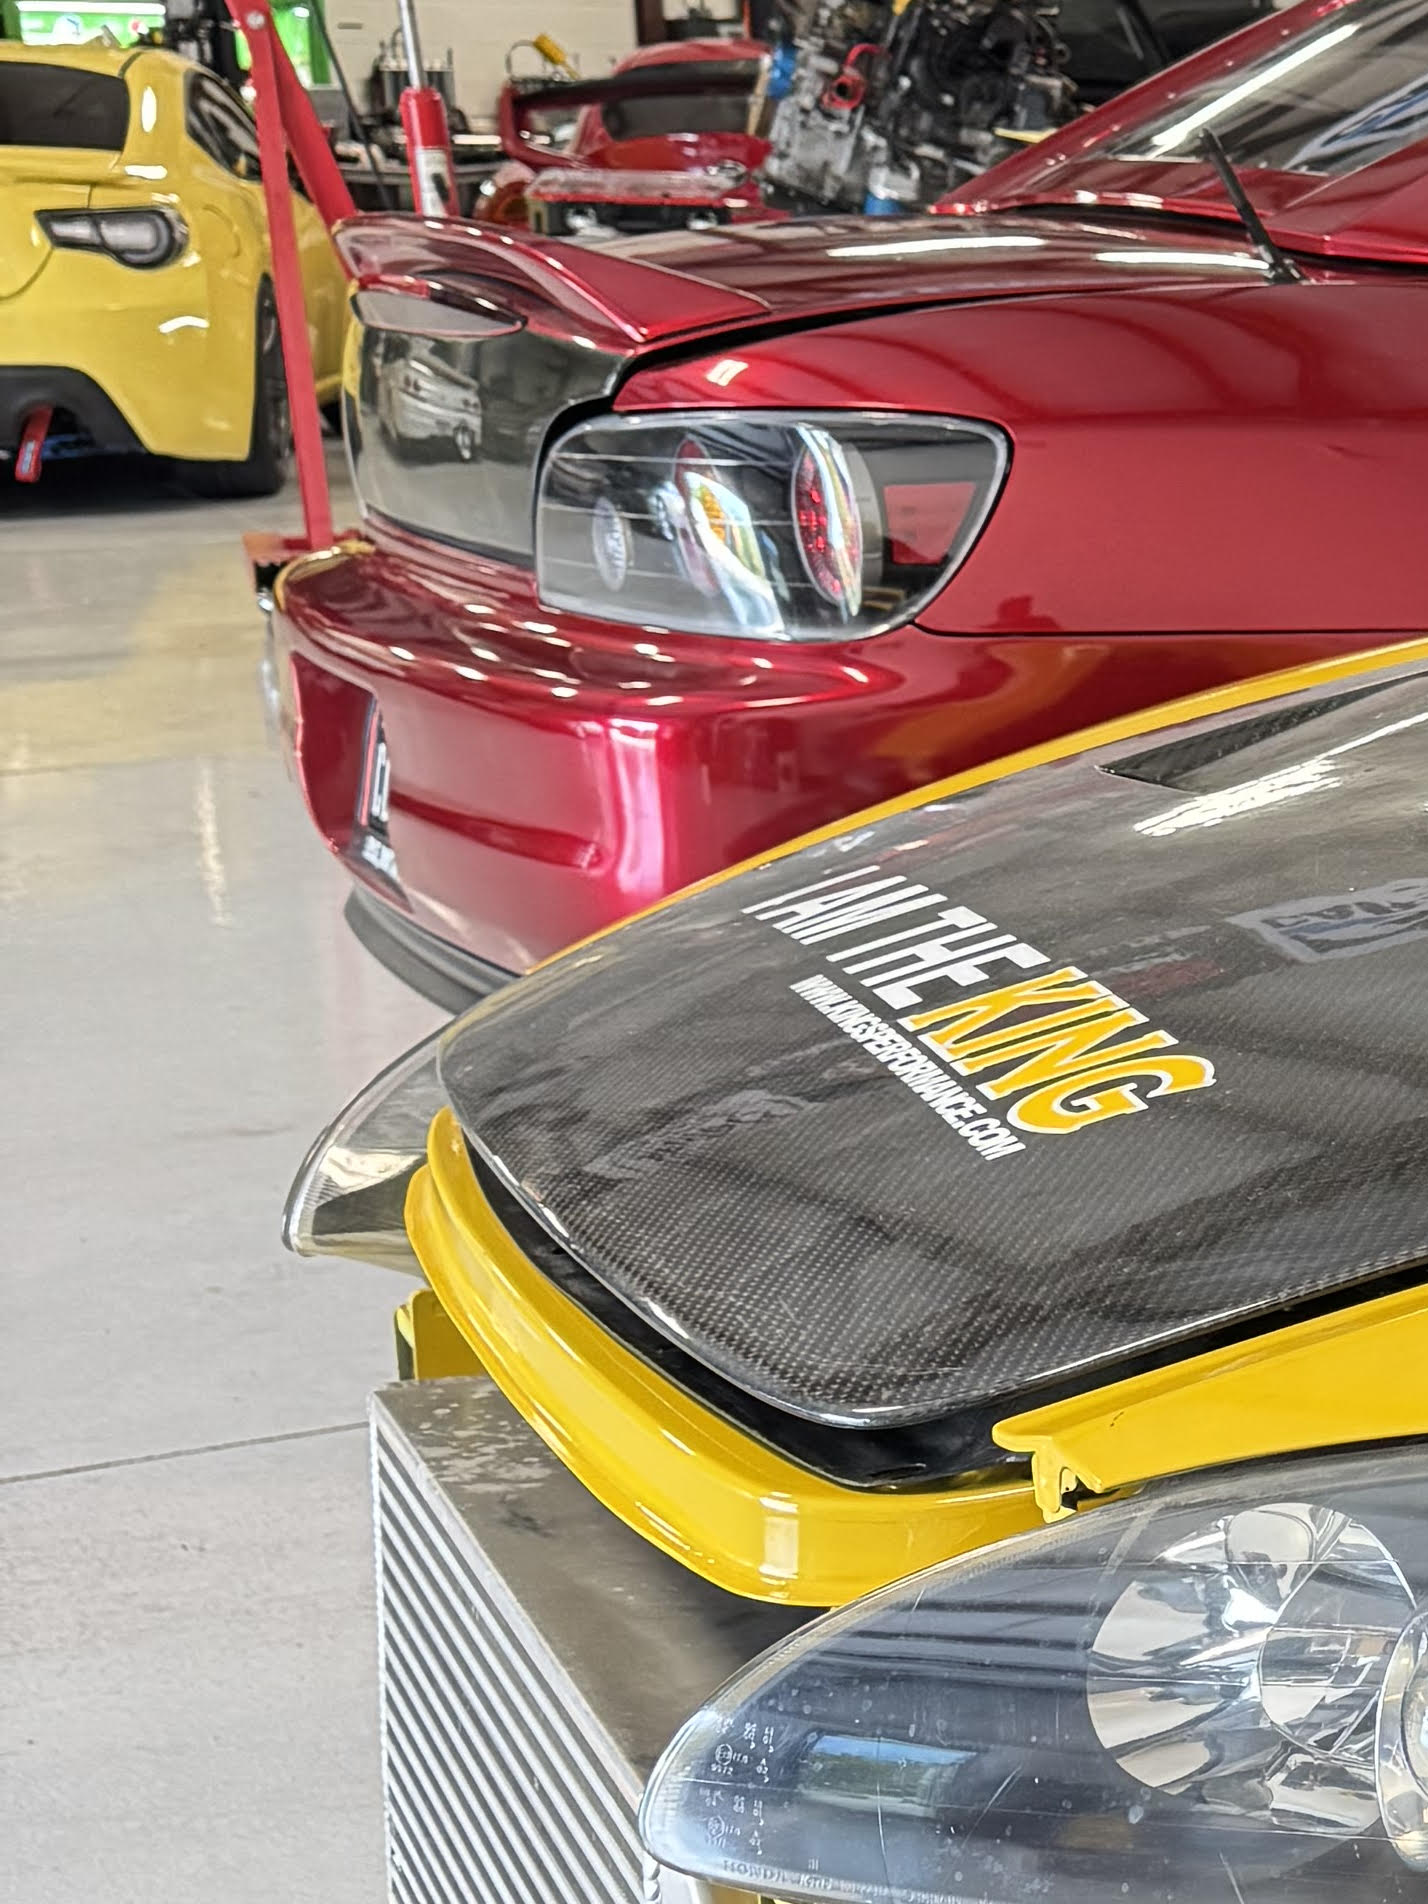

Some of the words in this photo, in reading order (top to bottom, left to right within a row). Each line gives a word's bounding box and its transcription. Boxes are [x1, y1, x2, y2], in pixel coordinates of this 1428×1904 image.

[826, 906, 1051, 1009] THE
[789, 974, 1027, 1161] WWW.KINGSPERFORMANCE.COM
[897, 966, 1217, 1134] KING
